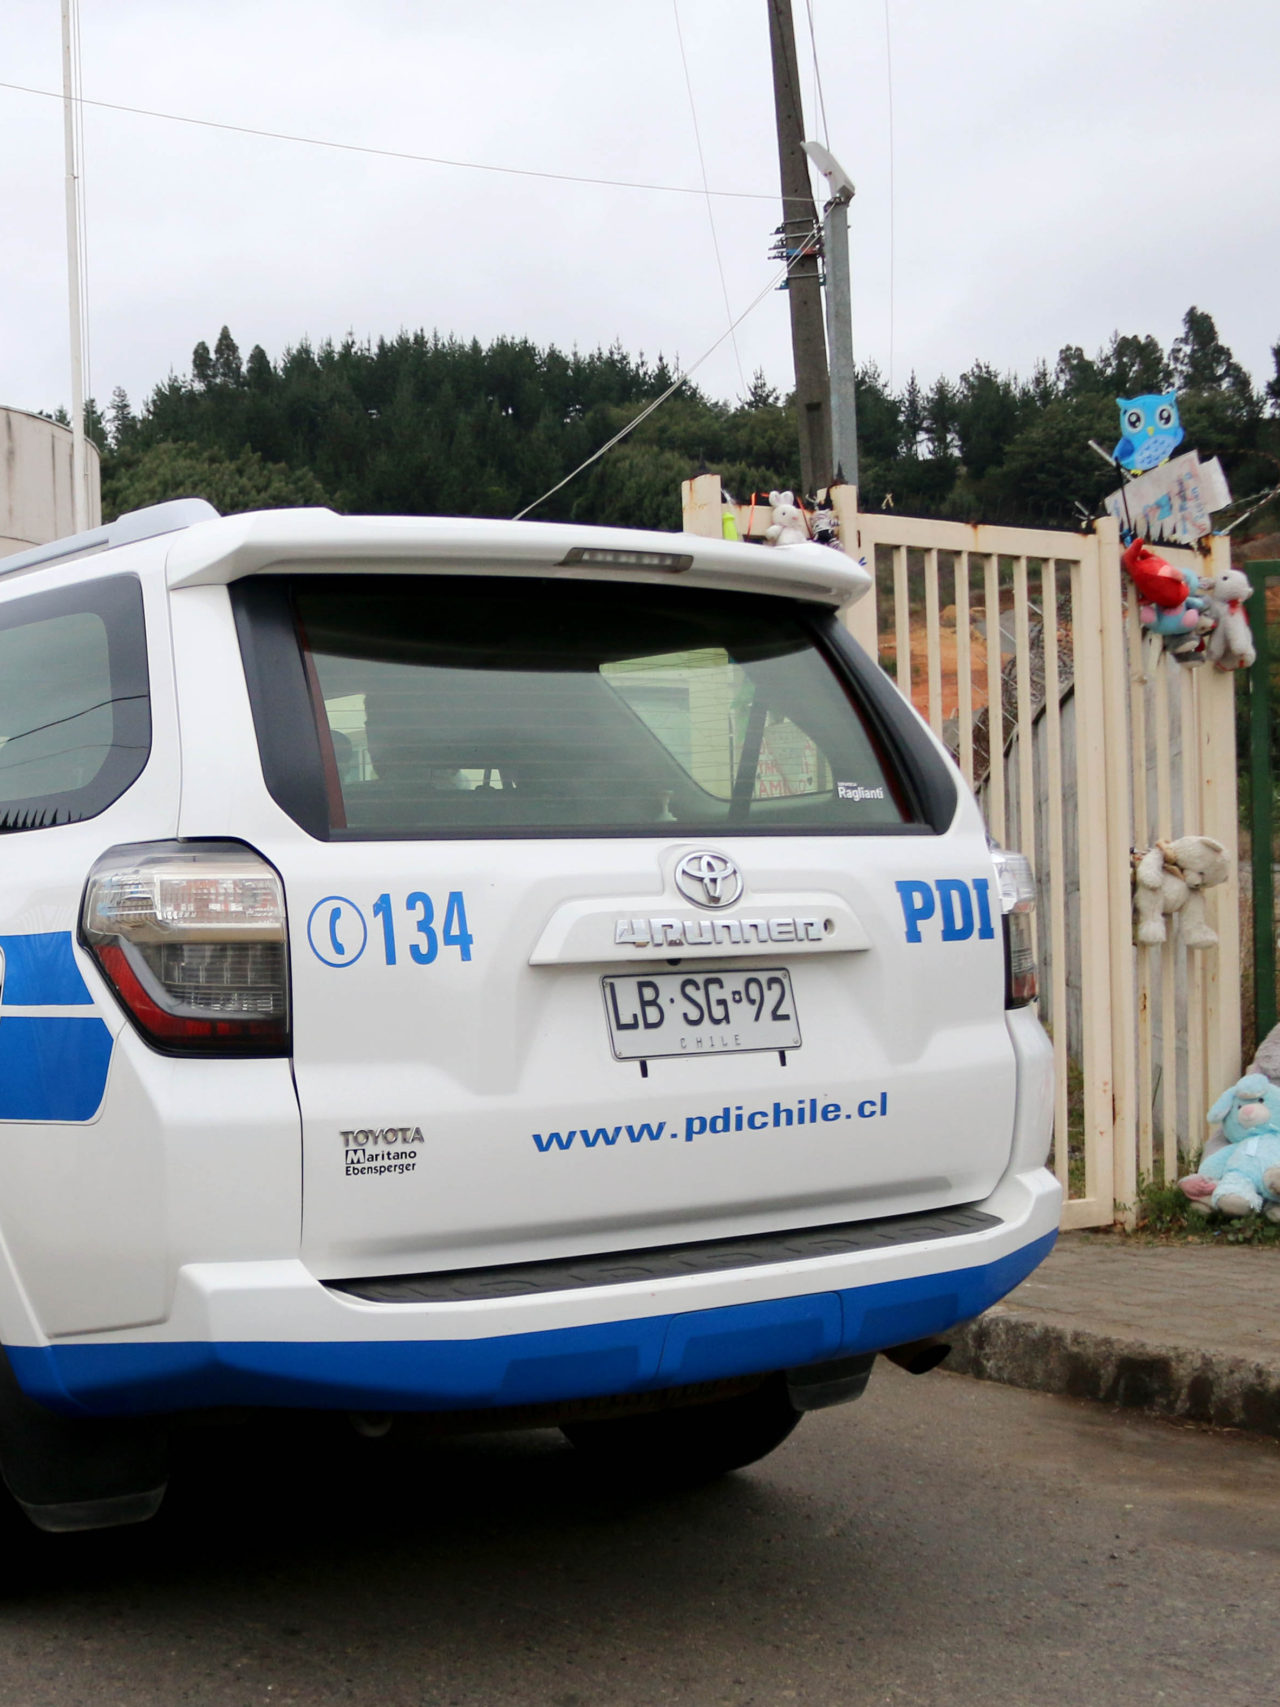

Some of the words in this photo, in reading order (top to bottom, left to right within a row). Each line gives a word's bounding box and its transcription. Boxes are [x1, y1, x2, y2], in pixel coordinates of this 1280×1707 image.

[837, 786, 884, 801] Raglianti
[894, 878, 995, 943] PDI
[373, 891, 473, 965] 134
[615, 917, 822, 947] 4RUNNER
[680, 1034, 741, 1049] CHILE
[531, 1091, 888, 1152] www.pdichile.cl
[339, 1126, 424, 1147] TOYOTA
[345, 1148, 417, 1165] Maritano
[345, 1162, 417, 1176] Ebensperger
